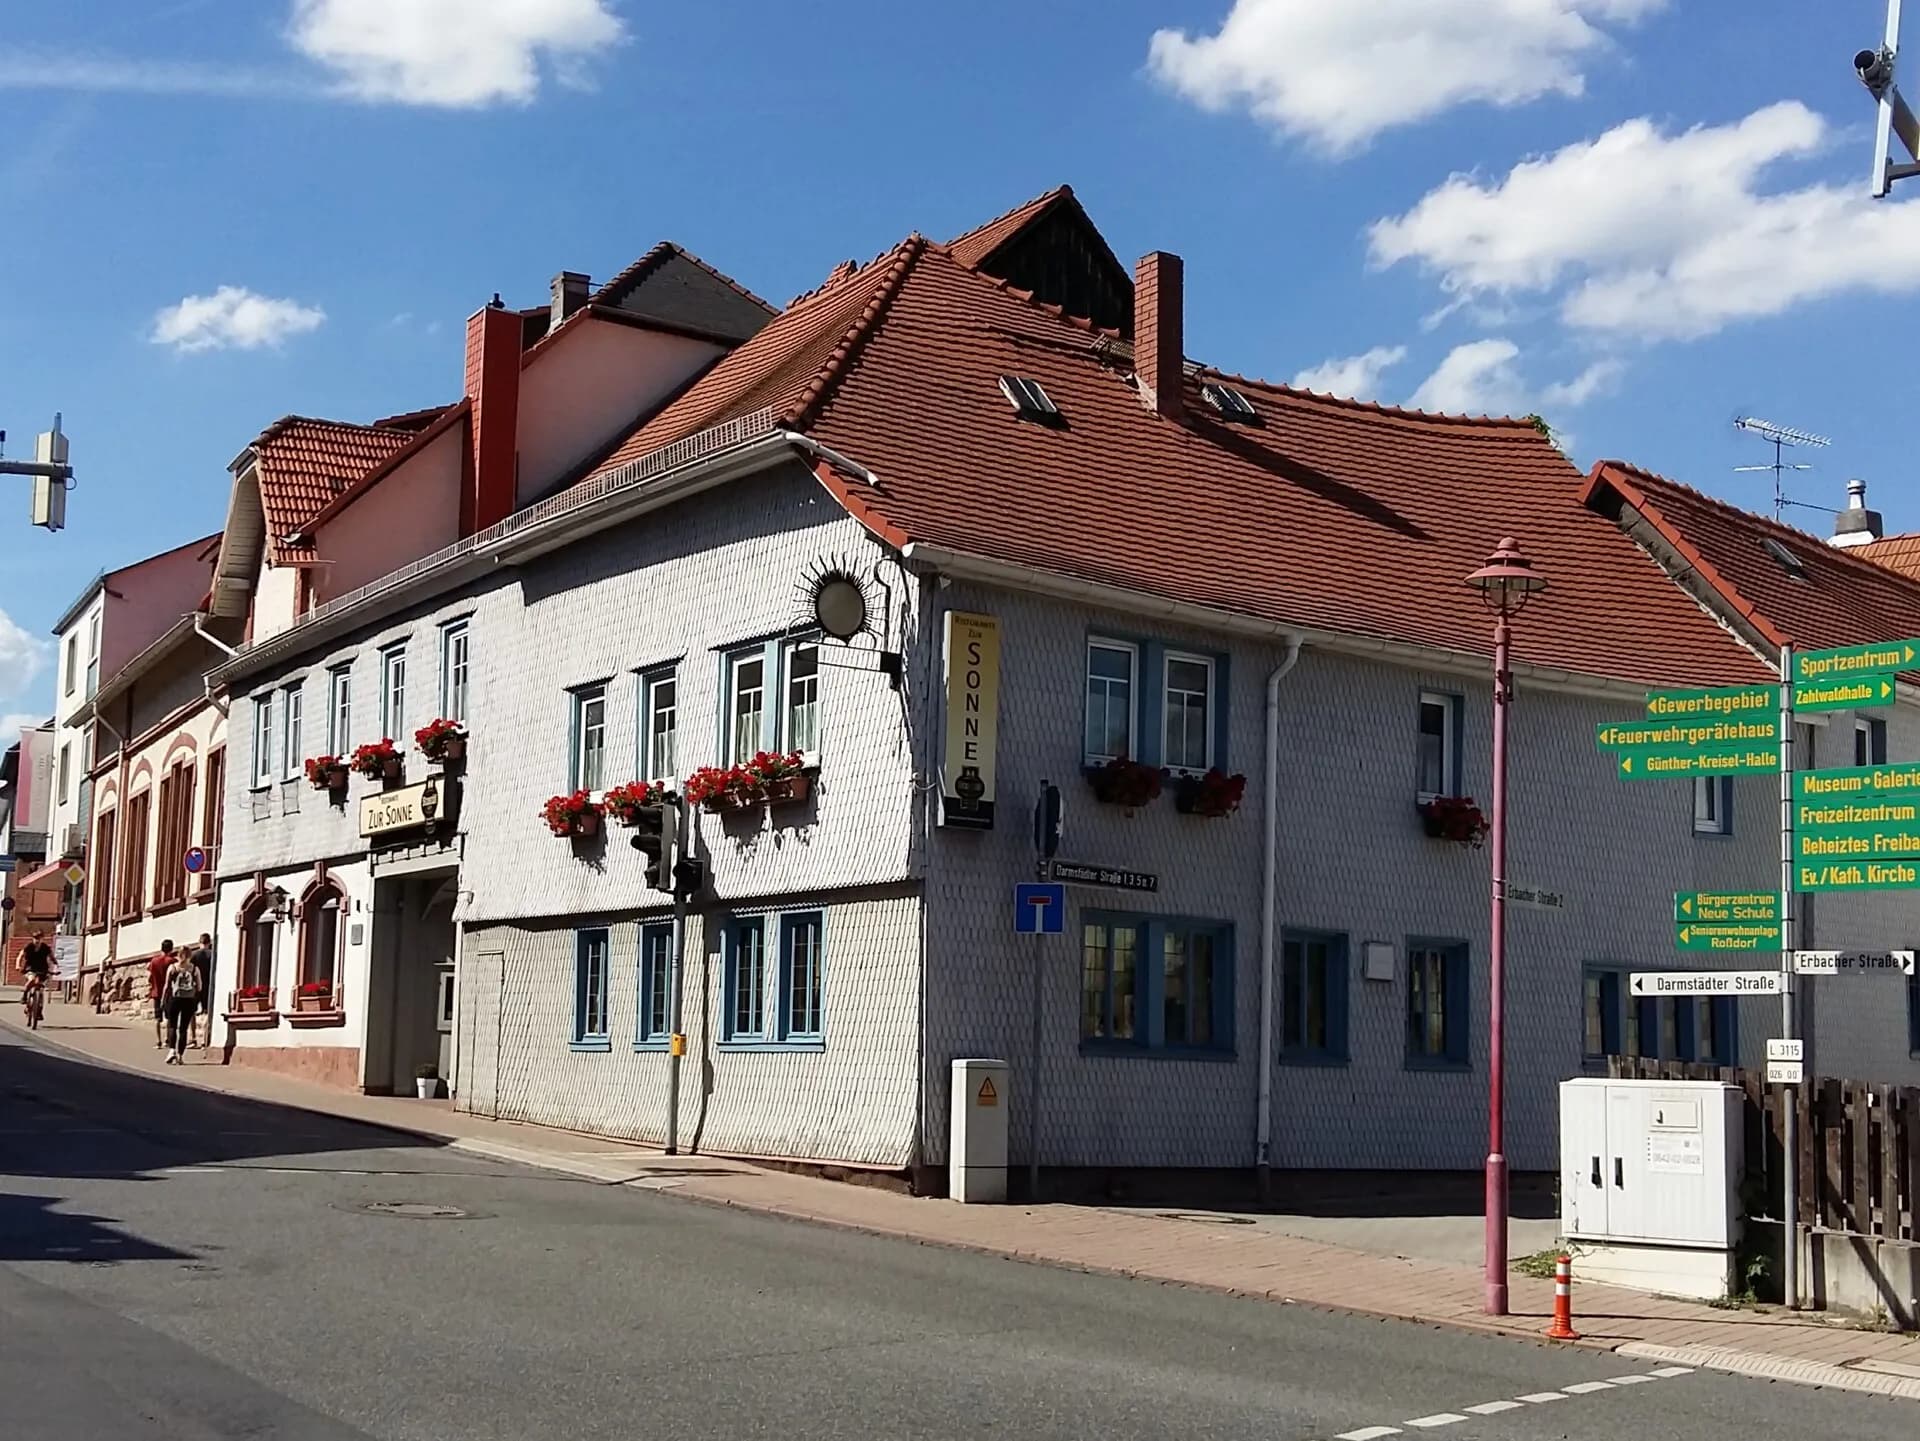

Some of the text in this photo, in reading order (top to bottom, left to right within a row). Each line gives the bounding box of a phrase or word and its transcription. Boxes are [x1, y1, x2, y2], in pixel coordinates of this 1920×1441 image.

[1800, 650, 1900, 678] Sportzentrum
[964, 642, 982, 761] SONNE
[1657, 690, 1770, 714] Gewerbegebiet
[1795, 684, 1873, 705] Zahlwaldhalle
[1609, 721, 1774, 745] Feuerwehrgerätehaus
[1646, 751, 1777, 771] Günther-Kreisel-Halle
[1804, 775, 1862, 794] Museum
[368, 803, 413, 829] ZUR SONNE
[1800, 803, 1915, 825] Freizeitzentrum
[1802, 835, 1870, 855] Beheiztes
[1867, 863, 1916, 884] Kirche
[1697, 892, 1775, 907] Bürgerzentrum
[1698, 906, 1774, 919] Neue Schule
[1711, 936, 1758, 948] Roßdorf
[1800, 953, 1900, 968] Erbacher Straße
[1656, 975, 1775, 991] Darmstädter Straße
[1769, 1044, 1800, 1056] L 3115
